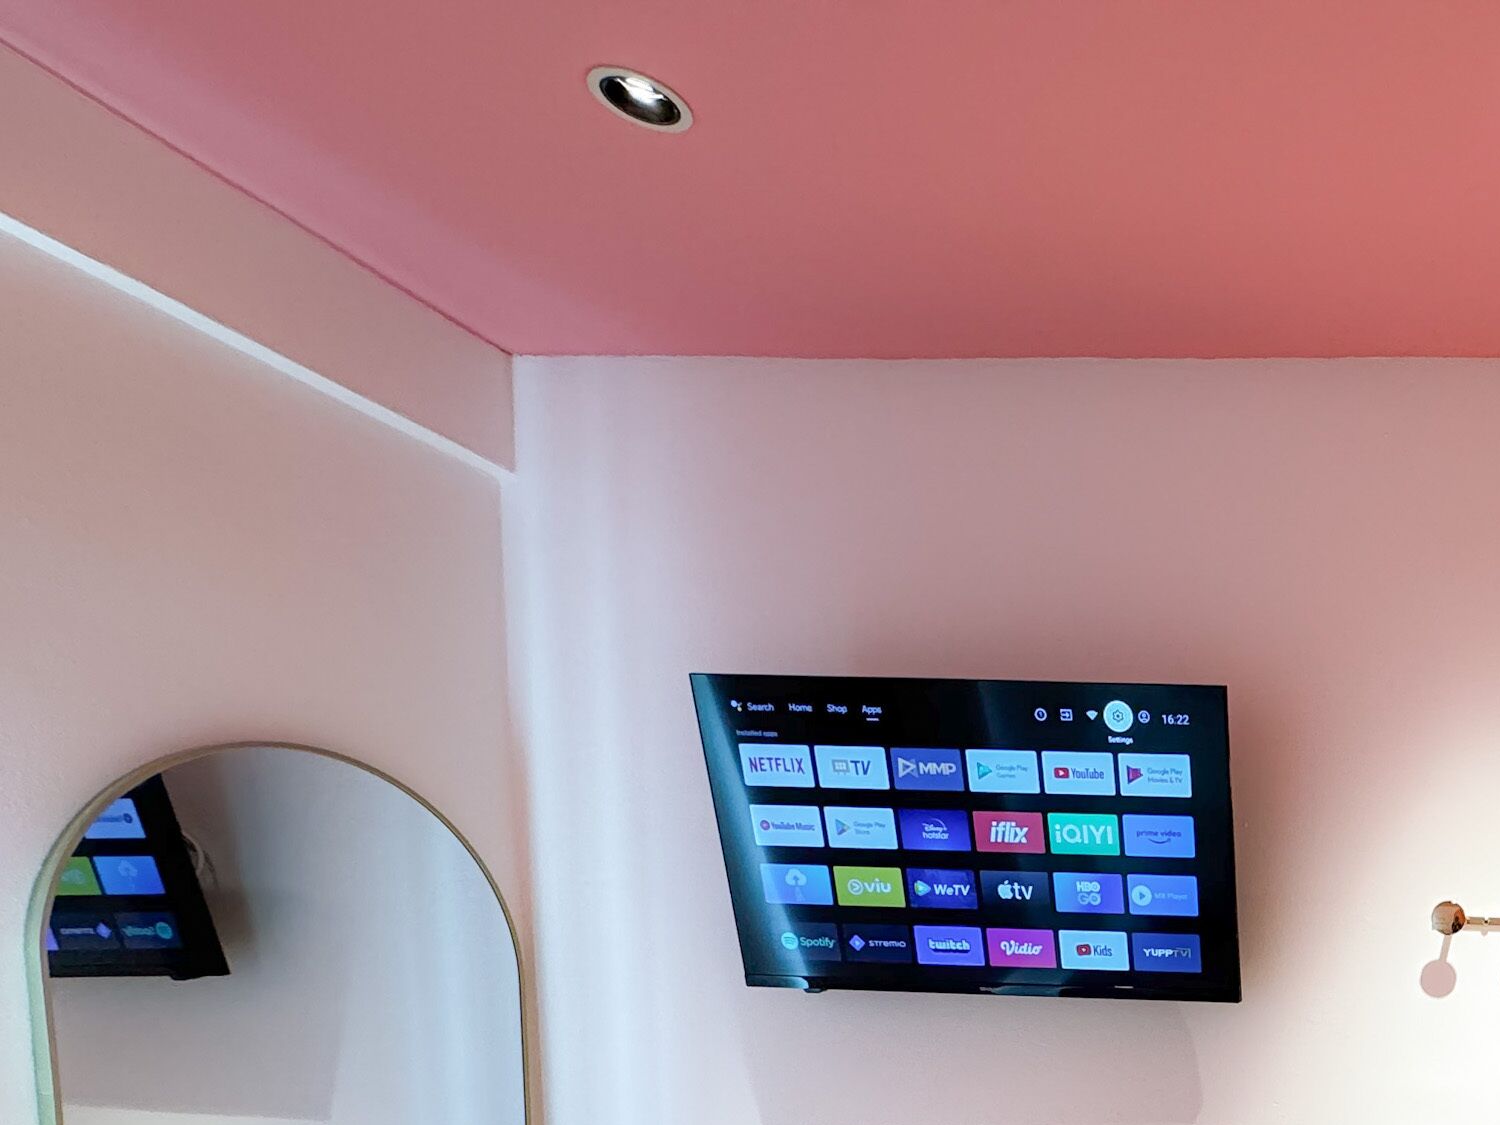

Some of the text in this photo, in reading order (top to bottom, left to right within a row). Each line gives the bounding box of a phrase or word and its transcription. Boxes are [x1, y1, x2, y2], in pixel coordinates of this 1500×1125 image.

[746, 702, 775, 712] Search
[788, 703, 813, 712] Home
[827, 703, 848, 715] Shop
[861, 704, 882, 716] Apps
[1161, 714, 1190, 726] 16:22
[1107, 735, 1134, 745] Settings
[748, 757, 806, 775] NETFLIX
[850, 760, 871, 776] TV
[918, 761, 957, 776] MMP
[1070, 768, 1105, 780] YouTube
[989, 821, 1029, 844] iflix
[1054, 823, 1113, 845] iQIYI
[1136, 829, 1182, 839] prime video
[864, 878, 892, 894] viu
[933, 883, 971, 897] WeTV
[1012, 882, 1034, 900] tv
[1075, 881, 1101, 893] HBO
[1078, 892, 1102, 906] GO
[800, 936, 835, 949] Spotify
[928, 938, 971, 951] twitch
[1000, 940, 1043, 956] Vidio
[1093, 945, 1113, 957] Kids
